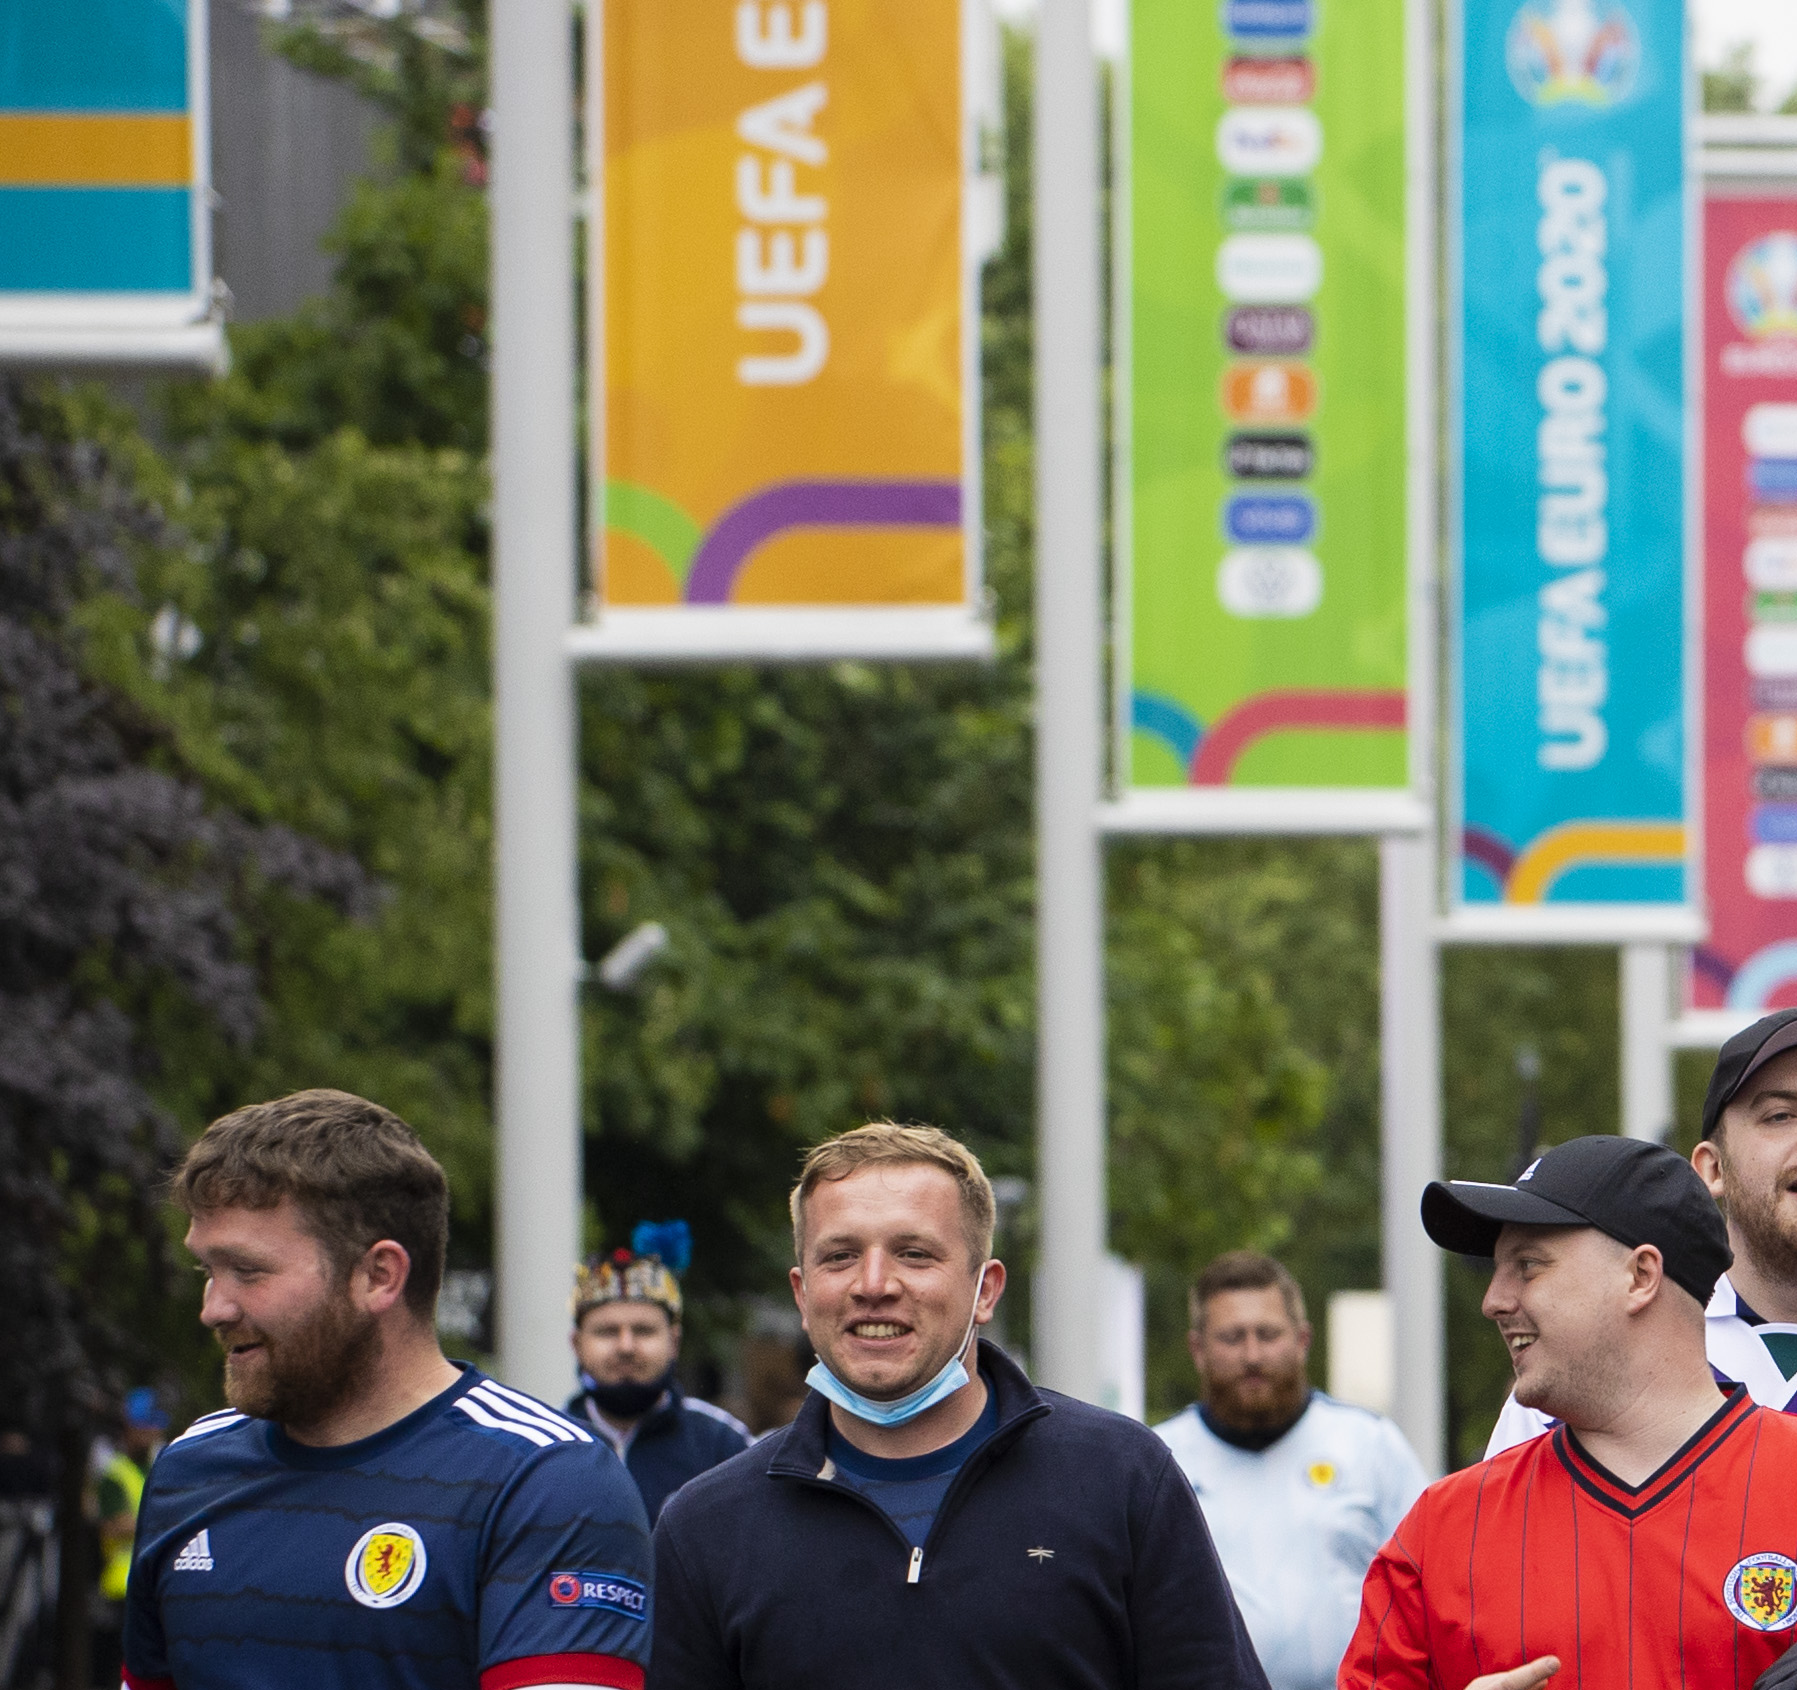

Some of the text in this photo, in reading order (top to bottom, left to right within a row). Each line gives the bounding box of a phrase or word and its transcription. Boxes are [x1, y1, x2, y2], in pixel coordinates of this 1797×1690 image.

[737, 84, 829, 387] UEFA
[1536, 156, 1609, 771] UEFA EURO 2020
[583, 1582, 646, 1610] RESPECT
